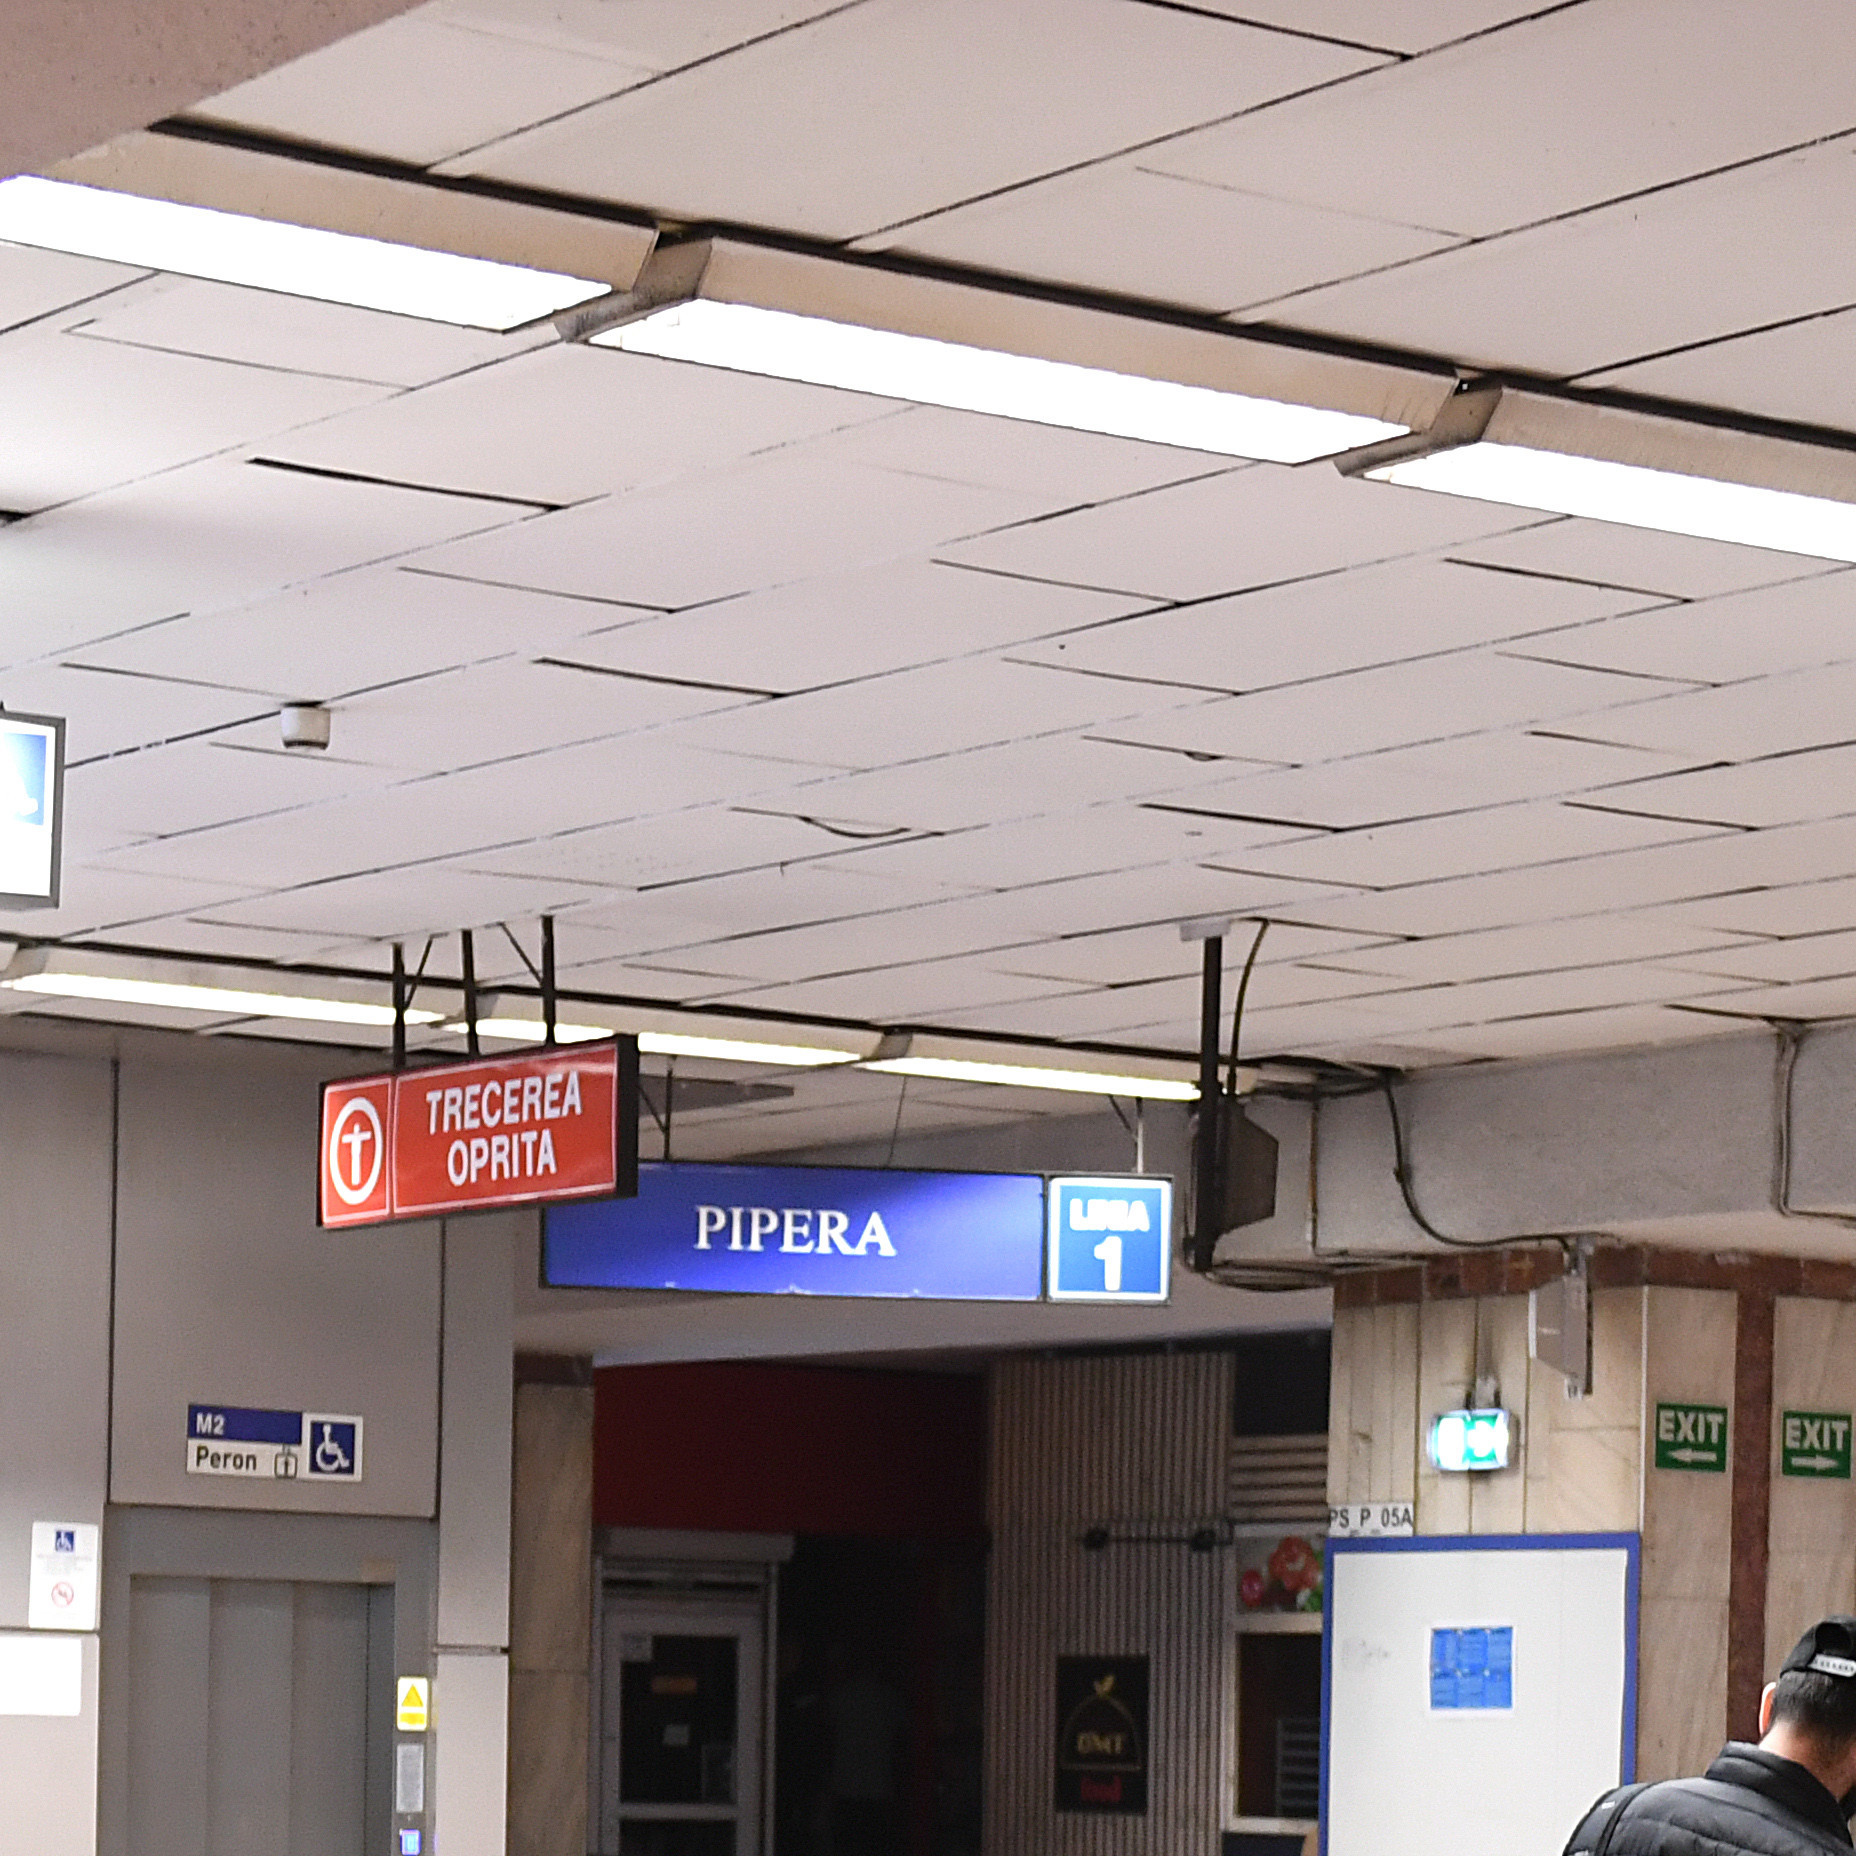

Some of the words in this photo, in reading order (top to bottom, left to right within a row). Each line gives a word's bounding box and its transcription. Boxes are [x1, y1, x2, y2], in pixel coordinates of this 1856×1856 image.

[426, 1071, 582, 1135] TRECEREA
[447, 1129, 557, 1187] OPRITA
[693, 1205, 898, 1258] PIPERA
[1093, 1235, 1123, 1291] 1
[196, 1412, 226, 1436] M2
[1658, 1409, 1724, 1444] EXIT
[1785, 1418, 1849, 1451] EXIT
[196, 1445, 257, 1471] Peron
